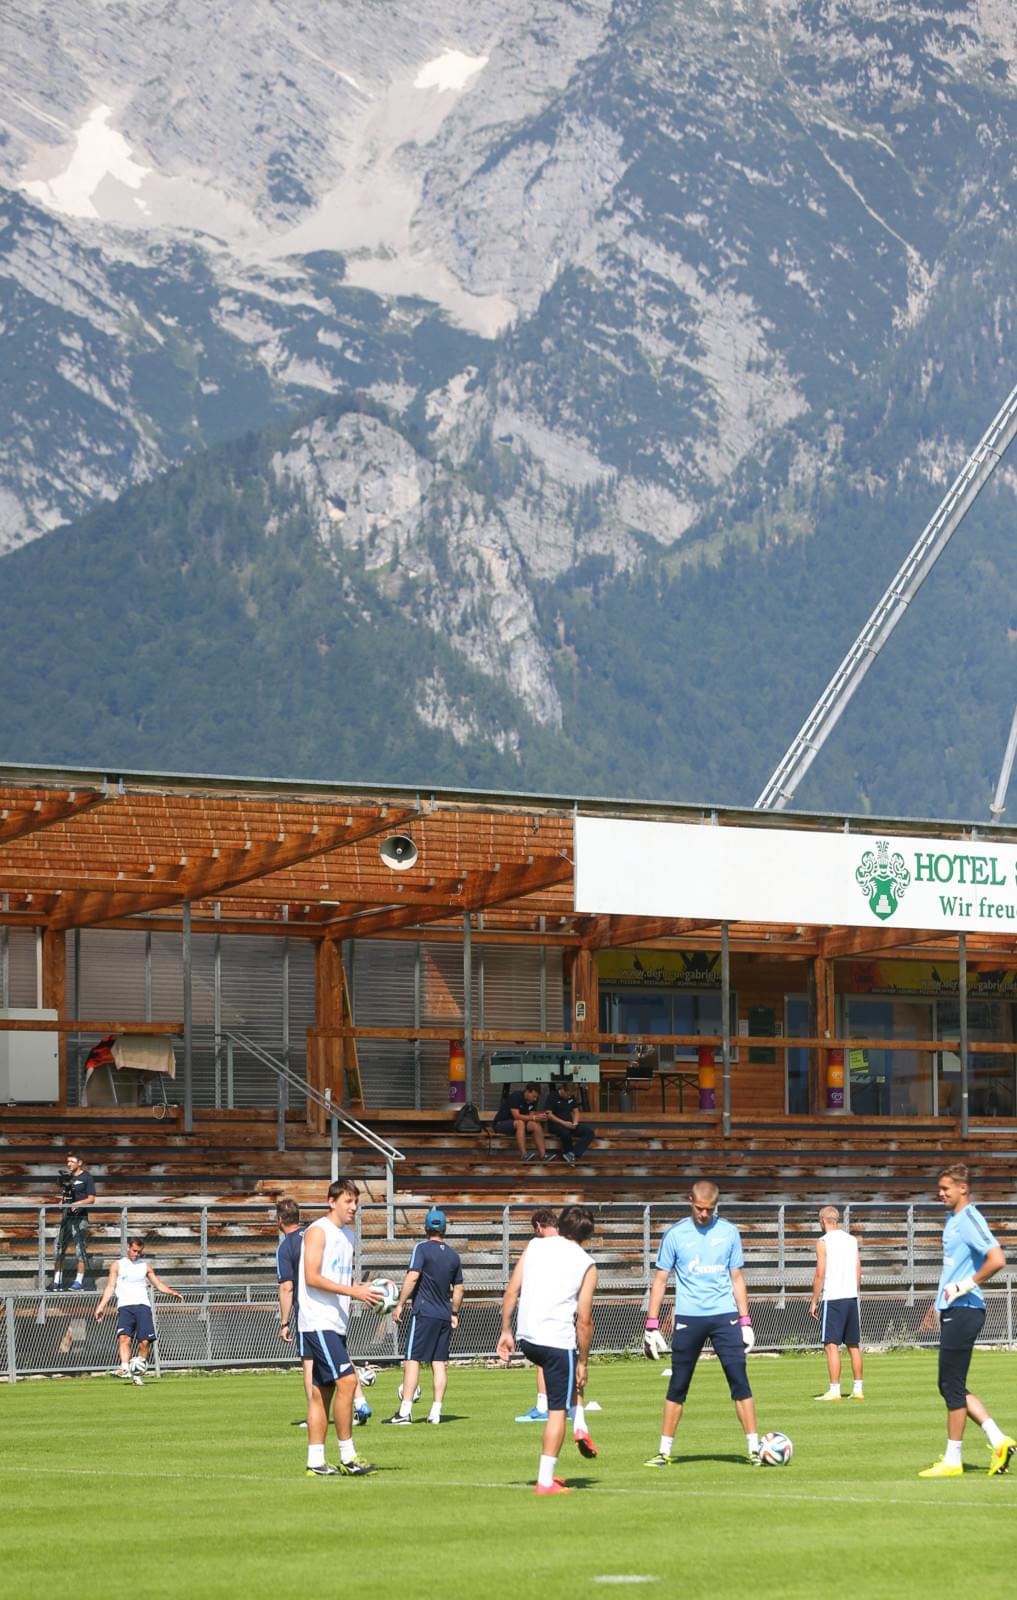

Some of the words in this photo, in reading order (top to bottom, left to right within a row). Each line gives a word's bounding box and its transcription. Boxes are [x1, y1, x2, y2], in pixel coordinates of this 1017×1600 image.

[914, 853, 1006, 885] HOTEL
[939, 896, 972, 916] Wir
[979, 896, 1017, 918] freu
